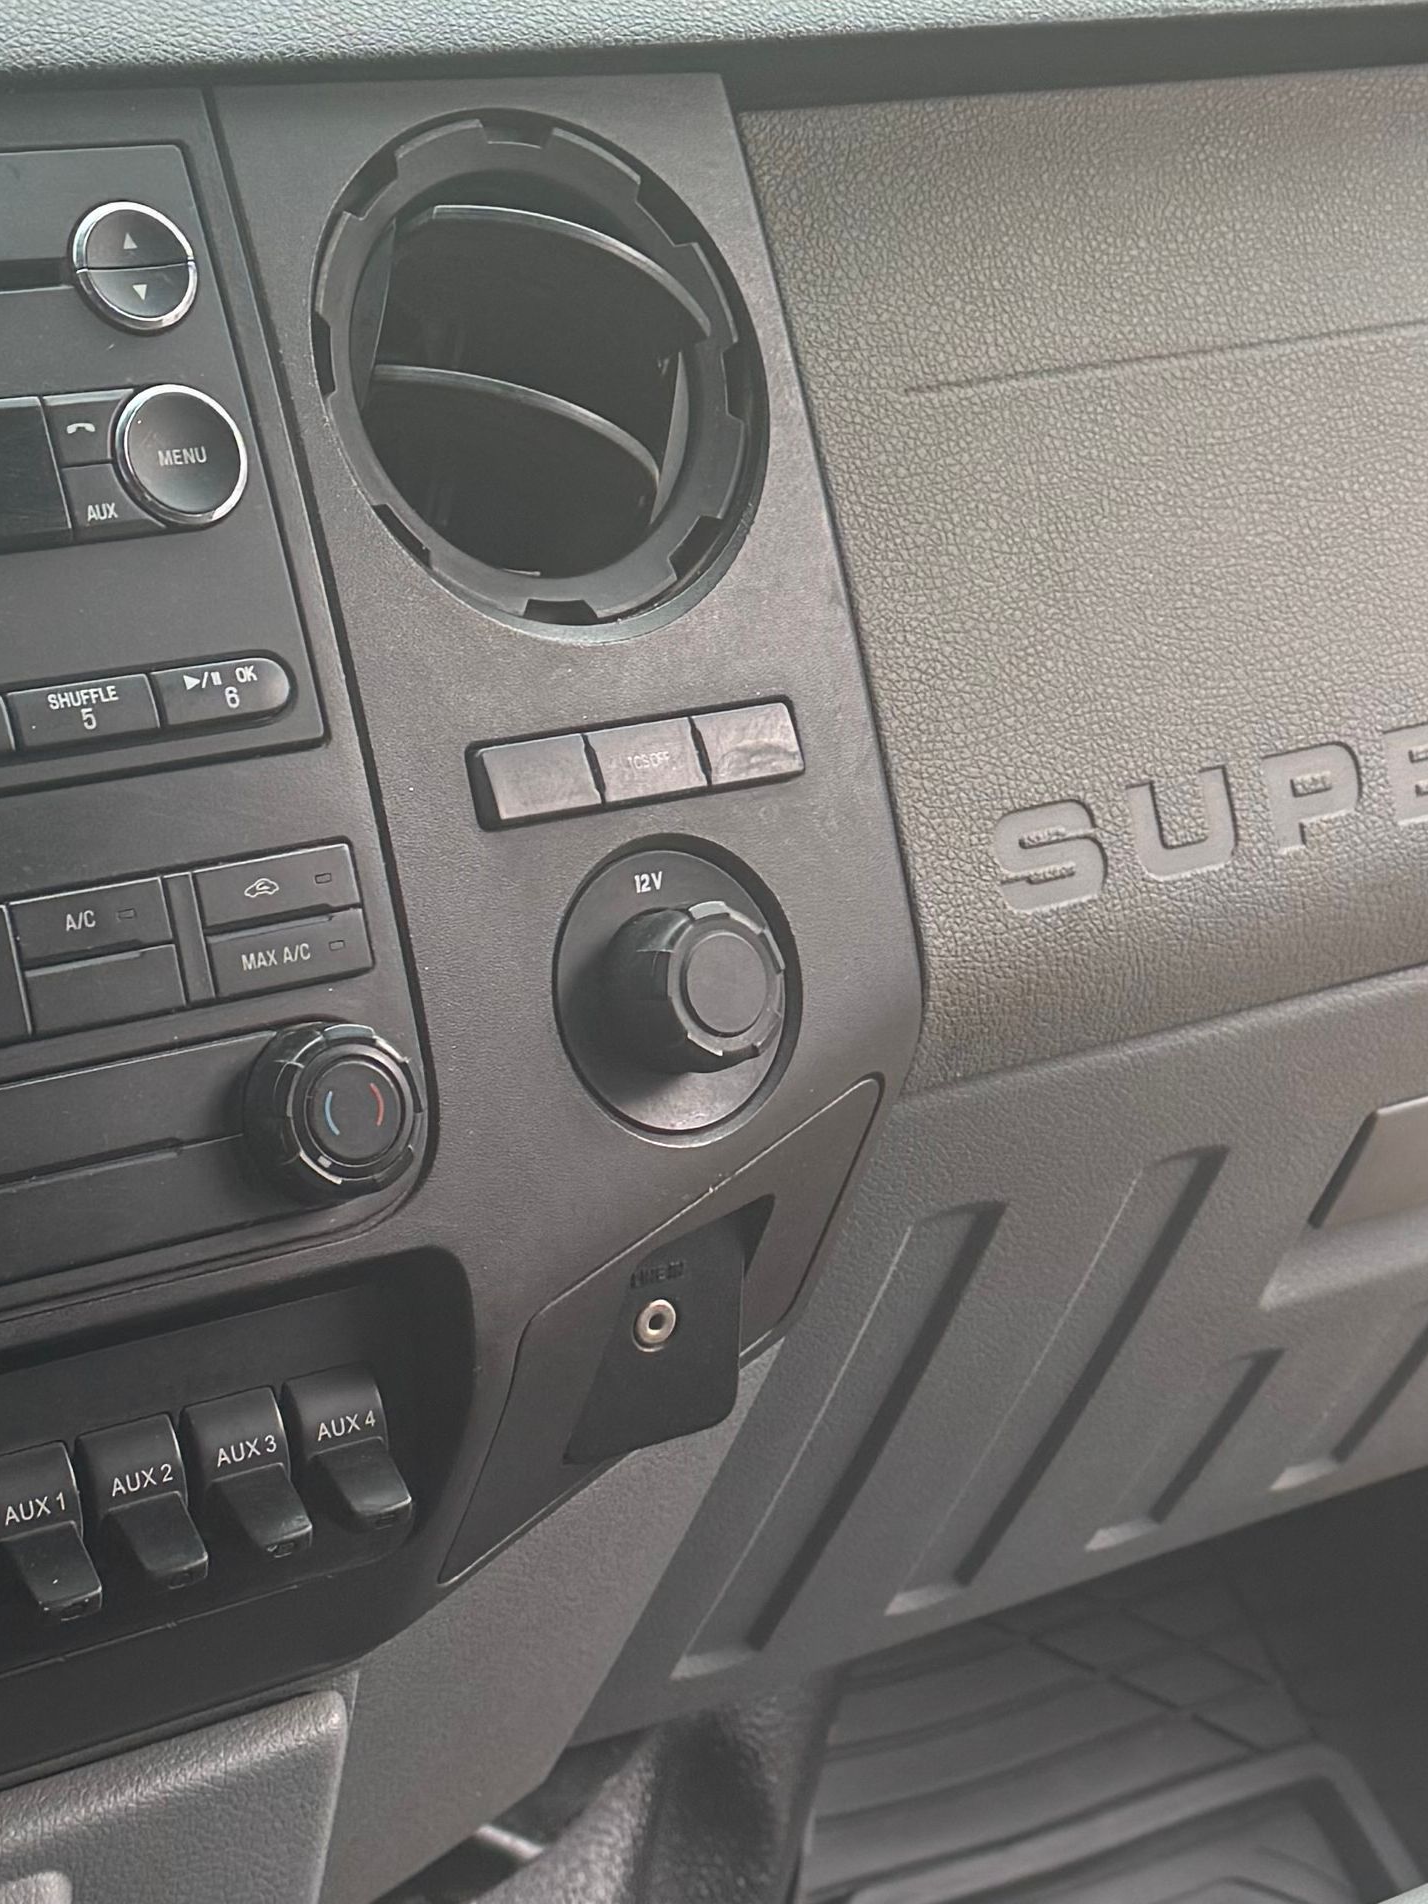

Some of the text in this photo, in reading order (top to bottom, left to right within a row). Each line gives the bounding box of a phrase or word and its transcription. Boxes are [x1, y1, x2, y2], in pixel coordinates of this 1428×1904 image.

[158, 446, 208, 467] MENU
[87, 502, 118, 521] AUX
[235, 665, 259, 684] OK
[47, 684, 120, 710] SHUFFLE
[224, 685, 240, 709] 6
[82, 707, 98, 731] 5
[634, 870, 663, 894] 12V
[65, 909, 97, 932] A/C
[241, 942, 312, 971] MAX A/C
[316, 1409, 377, 1442] AUX 4
[216, 1435, 278, 1468] AUX 3
[111, 1462, 174, 1498] AUX 2
[4, 1491, 66, 1526] AUX 1
